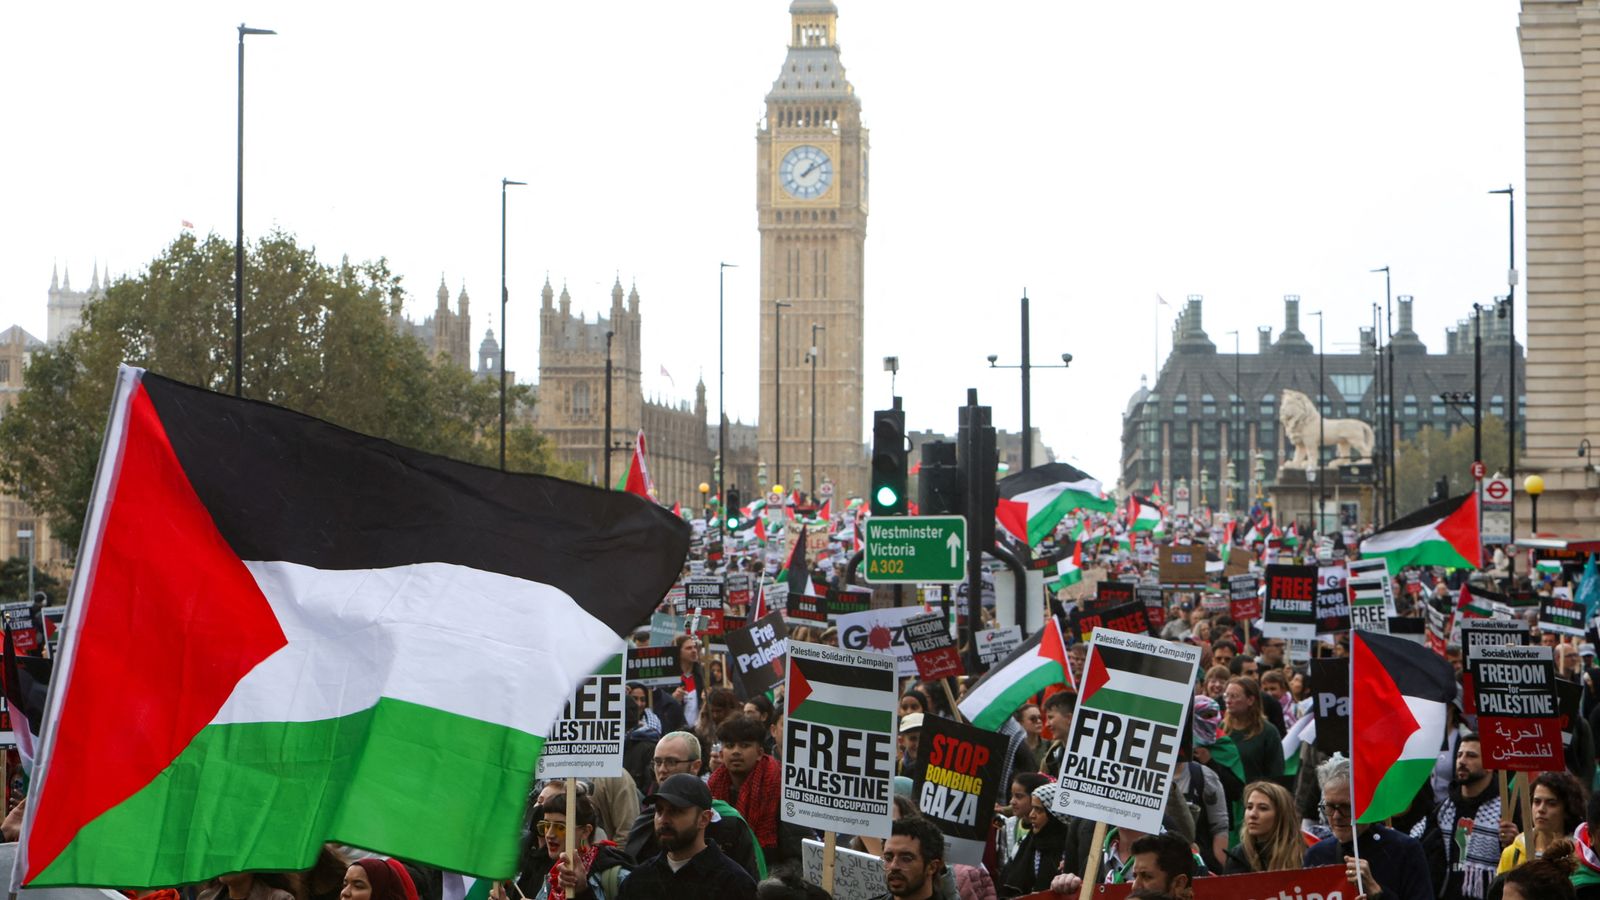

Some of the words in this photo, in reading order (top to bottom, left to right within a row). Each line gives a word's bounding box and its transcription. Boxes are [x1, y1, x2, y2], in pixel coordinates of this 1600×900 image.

[1475, 464, 1482, 477] E
[870, 525, 943, 539] Westminster
[870, 542, 916, 557] Victoria
[688, 585, 720, 595] FREEDOM
[1271, 576, 1312, 600] FREE
[687, 598, 722, 609] PALESTINE
[1270, 600, 1312, 612] PALESTINE
[1545, 605, 1582, 620] BOMBING
[1351, 606, 1386, 623] FREE
[749, 622, 775, 647] Free
[908, 620, 944, 638] FREEDOM
[1471, 620, 1495, 629] Socialist
[1496, 621, 1519, 630] Worker
[910, 635, 952, 653] PALESTINE
[1094, 632, 1125, 647] Palestine
[1125, 638, 1158, 654] Solidarity
[1158, 645, 1196, 661] Campaign
[1482, 648, 1512, 658] Socialist
[1512, 649, 1540, 659] Worker
[628, 656, 674, 669] BOMBING
[737, 637, 788, 674] Palestin
[790, 645, 820, 658] Palestine
[821, 650, 856, 665] Solidarity
[856, 656, 894, 670] Campaign
[1479, 663, 1546, 684] FREEDOM
[1508, 684, 1520, 695] for
[1479, 693, 1554, 714] PALESTINE
[1069, 708, 1178, 773] FREE
[1495, 721, 1544, 743] الحرية
[548, 745, 571, 755] ISRAELI
[571, 743, 619, 754] OCCUPATION
[786, 719, 891, 779] FREE
[929, 732, 990, 776] STOP
[1492, 743, 1553, 760] لفلسطين
[785, 764, 889, 801] PALESTINE
[925, 763, 983, 795] BOMBING
[1064, 753, 1167, 796] PALESTINE
[785, 788, 801, 801] END
[801, 791, 832, 807] ISRAELI
[832, 795, 888, 815] OCCUPATION
[1062, 777, 1079, 790] END
[1078, 781, 1108, 797] ISRAELI
[1108, 787, 1161, 809] OCCUPATION
[919, 781, 979, 827] GAZA
[798, 807, 870, 827] www.palestinecampaign.org
[840, 865, 855, 878] BE
